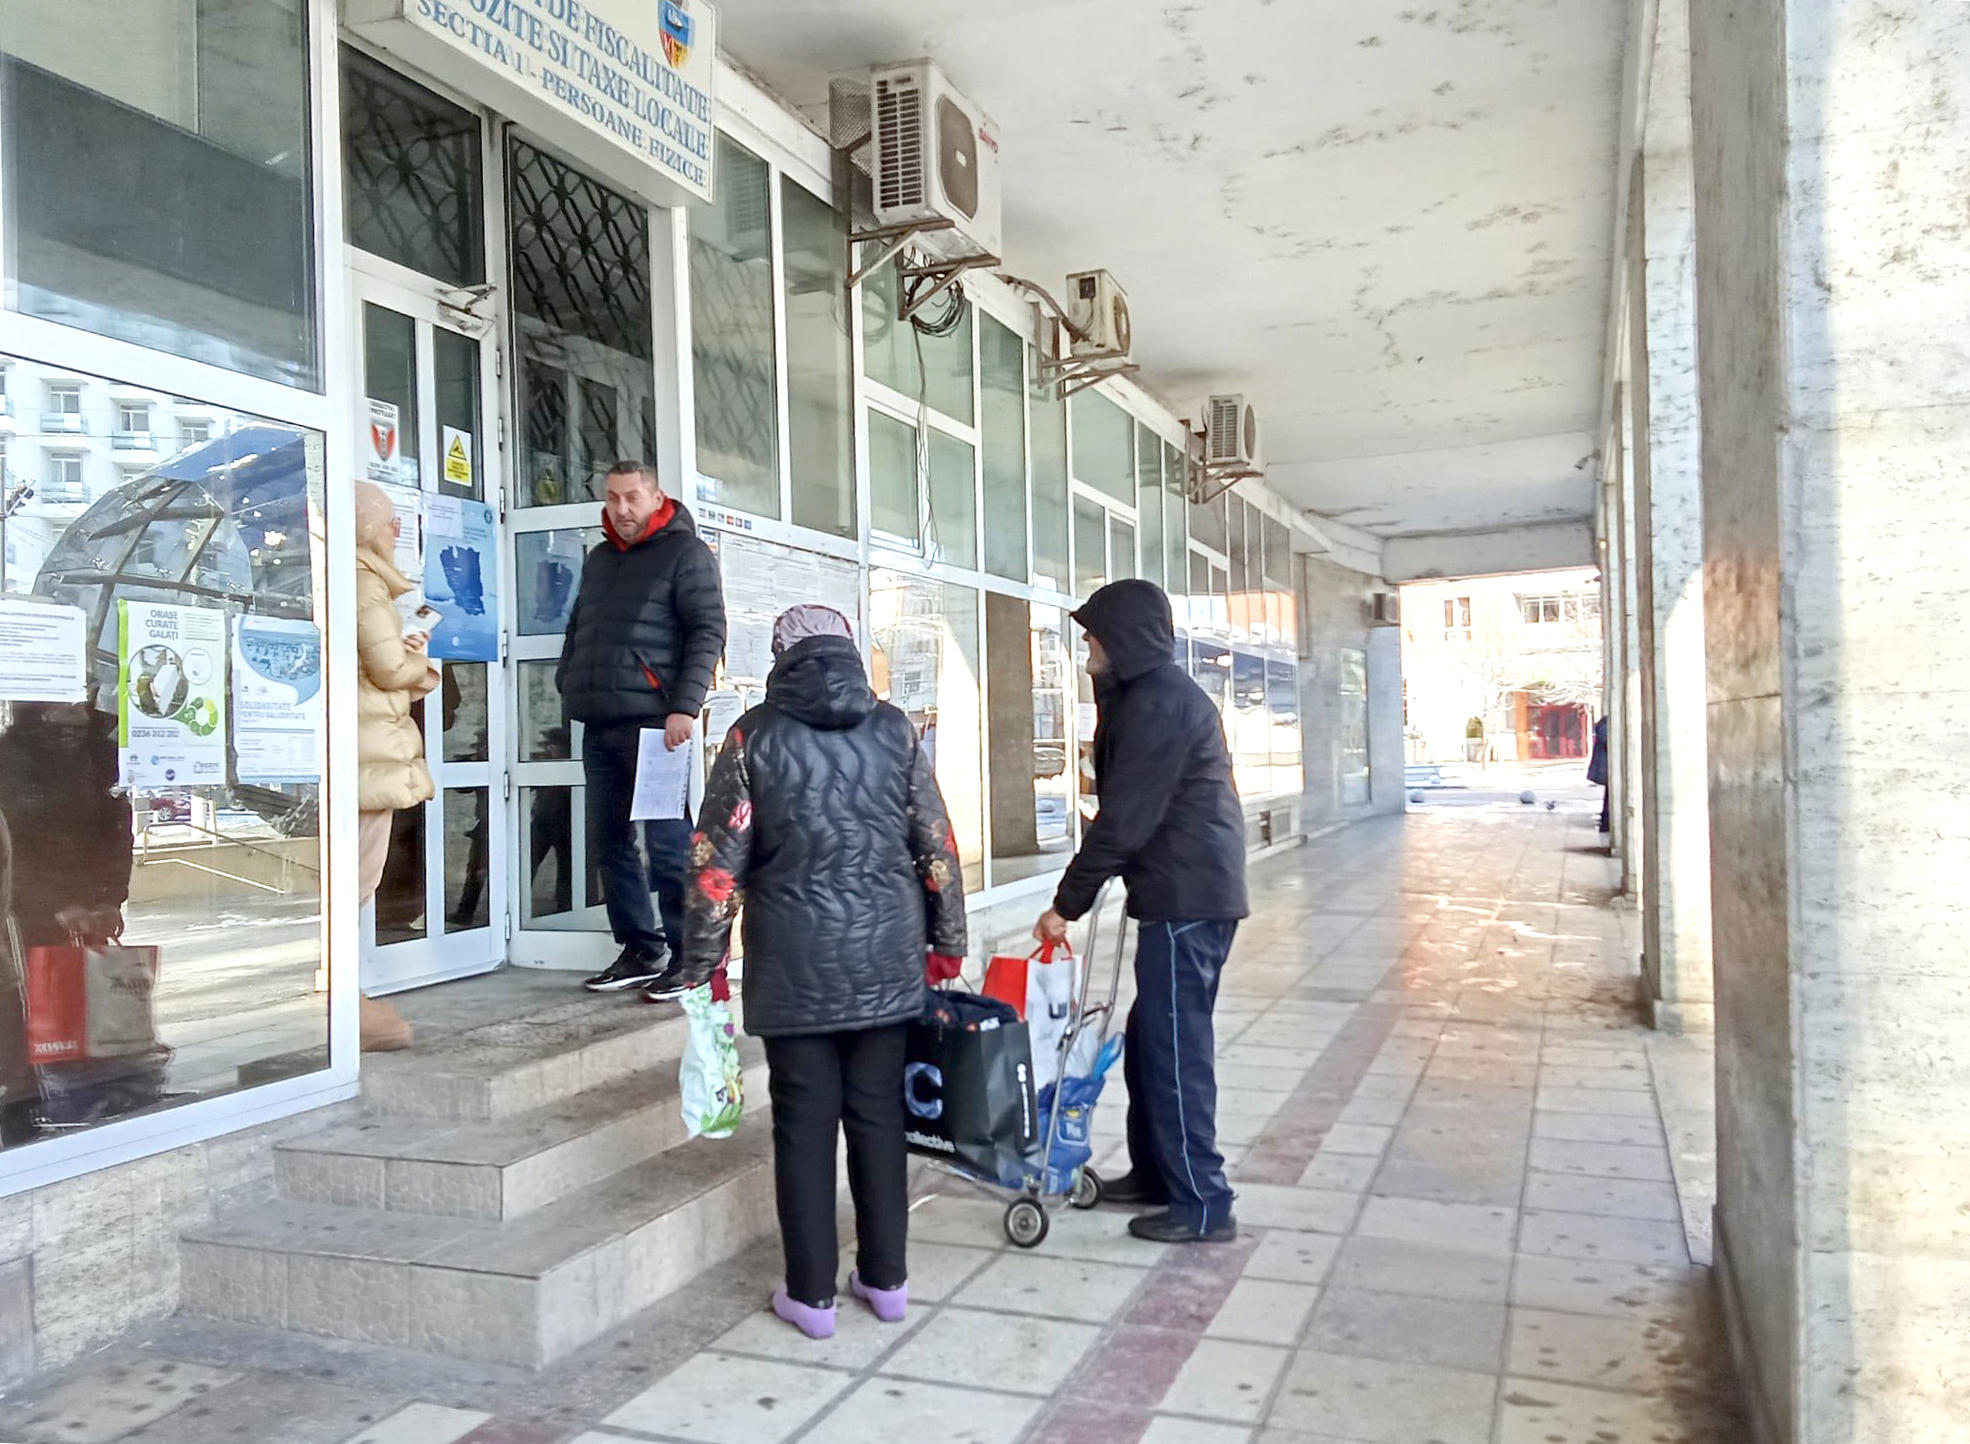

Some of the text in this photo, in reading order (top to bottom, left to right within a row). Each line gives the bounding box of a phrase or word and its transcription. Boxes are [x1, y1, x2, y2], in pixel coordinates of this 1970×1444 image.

[547, 0, 707, 123] DE FISCALITATE
[576, 47, 630, 109] TAXE
[633, 86, 706, 160] LOCALE
[541, 66, 643, 149] PERSOANE
[649, 136, 704, 187] FIZICE
[145, 619, 179, 630] CURATE
